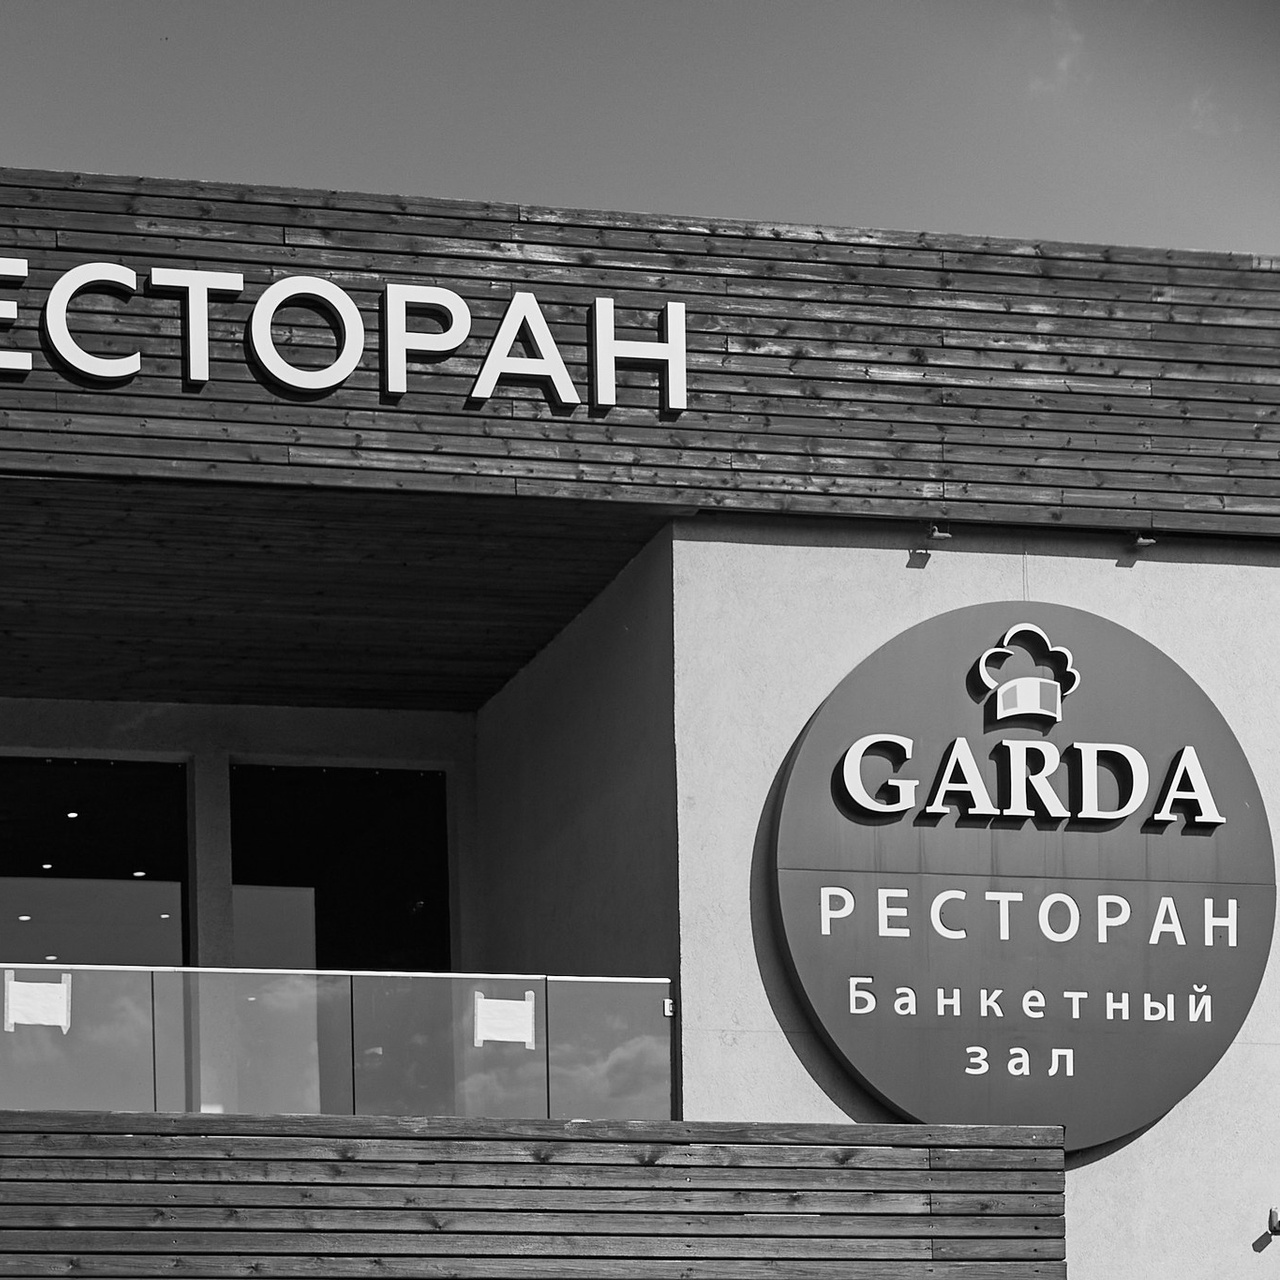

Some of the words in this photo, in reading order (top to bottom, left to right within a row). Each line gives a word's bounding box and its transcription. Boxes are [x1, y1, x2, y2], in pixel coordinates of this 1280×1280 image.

[841, 733, 1227, 825] GARDA
[820, 886, 1240, 948] РЕСТОРАН
[848, 976, 1213, 1024] Банкетный
[964, 1045, 1076, 1078] зал
